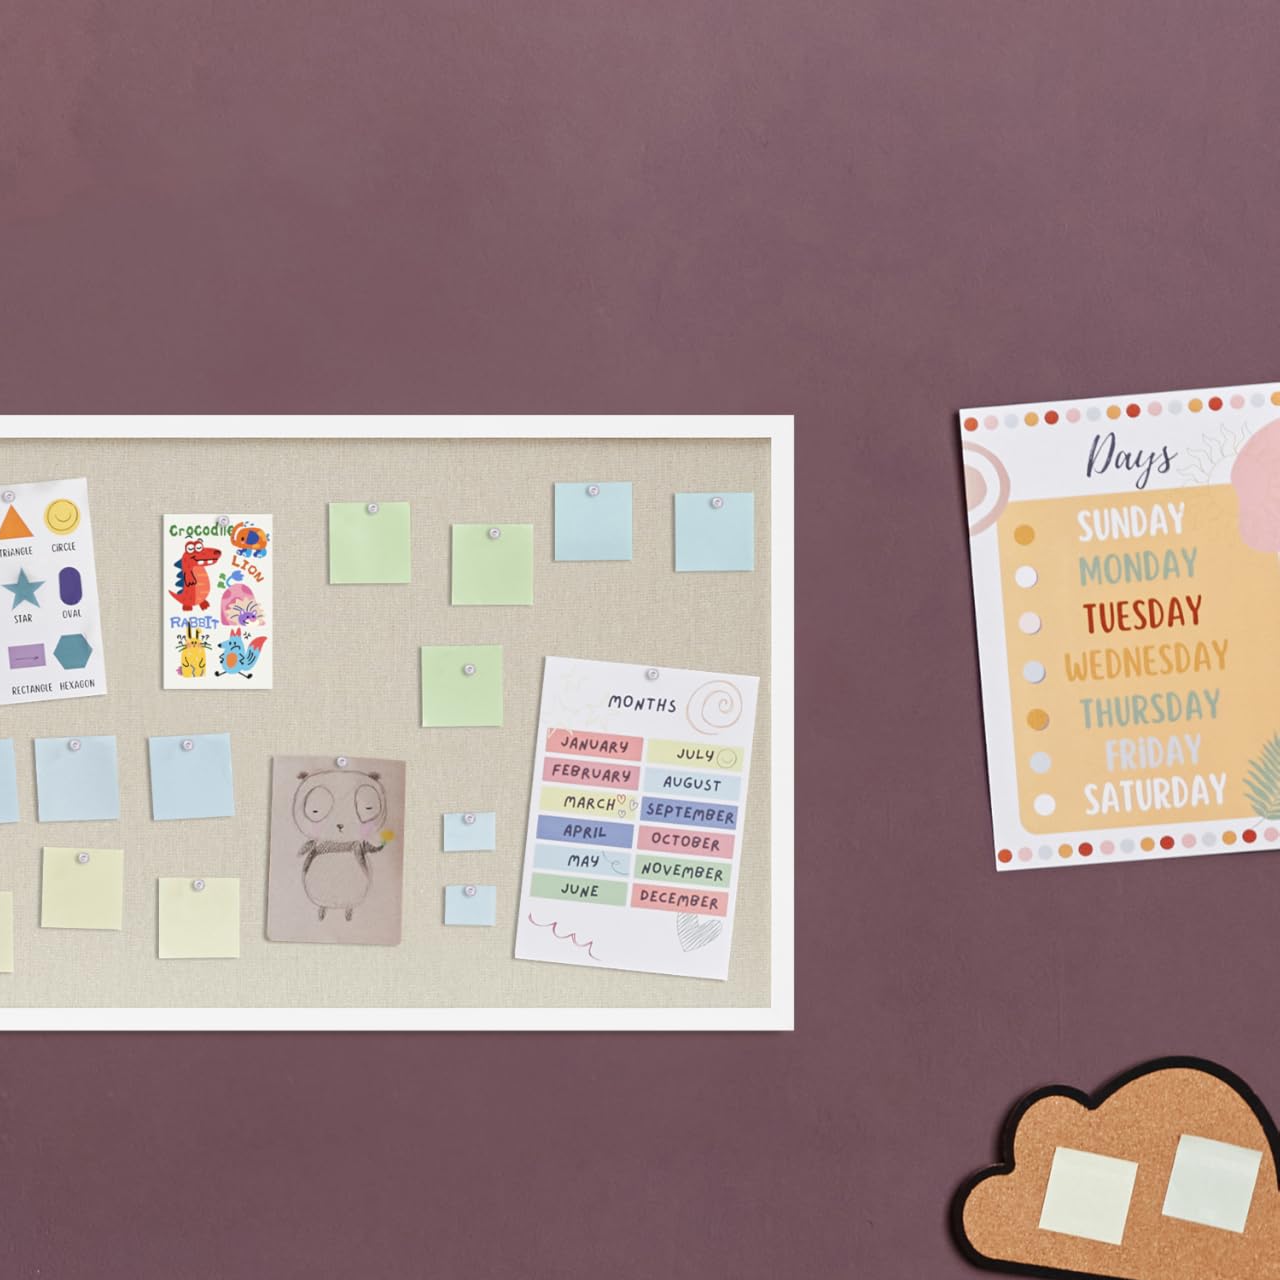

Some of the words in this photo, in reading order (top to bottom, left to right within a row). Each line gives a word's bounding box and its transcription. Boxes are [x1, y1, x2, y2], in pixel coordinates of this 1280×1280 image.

[1087, 432, 1177, 491] Days
[1078, 503, 1185, 542] SUNDAY
[231, 555, 264, 582] LION
[1079, 547, 1197, 586] MONDAY
[14, 614, 32, 623] STAR
[62, 608, 82, 618] OVAL
[1083, 595, 1201, 634] TUESDAY
[170, 616, 219, 629] RABBIT
[1065, 639, 1228, 683] WEDNESDAY
[12, 683, 52, 695] RECTANGLE
[60, 680, 95, 690] HEXAGON
[608, 695, 676, 712] MONTHS
[1080, 688, 1223, 729] THURSDAY
[561, 736, 629, 753] JANUARY
[677, 749, 714, 762] JULY
[552, 764, 632, 782] FEBRUARY
[663, 776, 721, 791] AUGUST
[1084, 773, 1226, 816] SATURDAY
[564, 796, 615, 811] MARCH
[646, 803, 734, 825] SEPTEMBER
[564, 824, 606, 839] APRIL
[651, 832, 720, 851] OCTOBER
[568, 855, 599, 867] MAY
[641, 862, 723, 882] NOVEMBER
[561, 884, 598, 897] JUNE
[640, 890, 719, 910] DECEMBER
